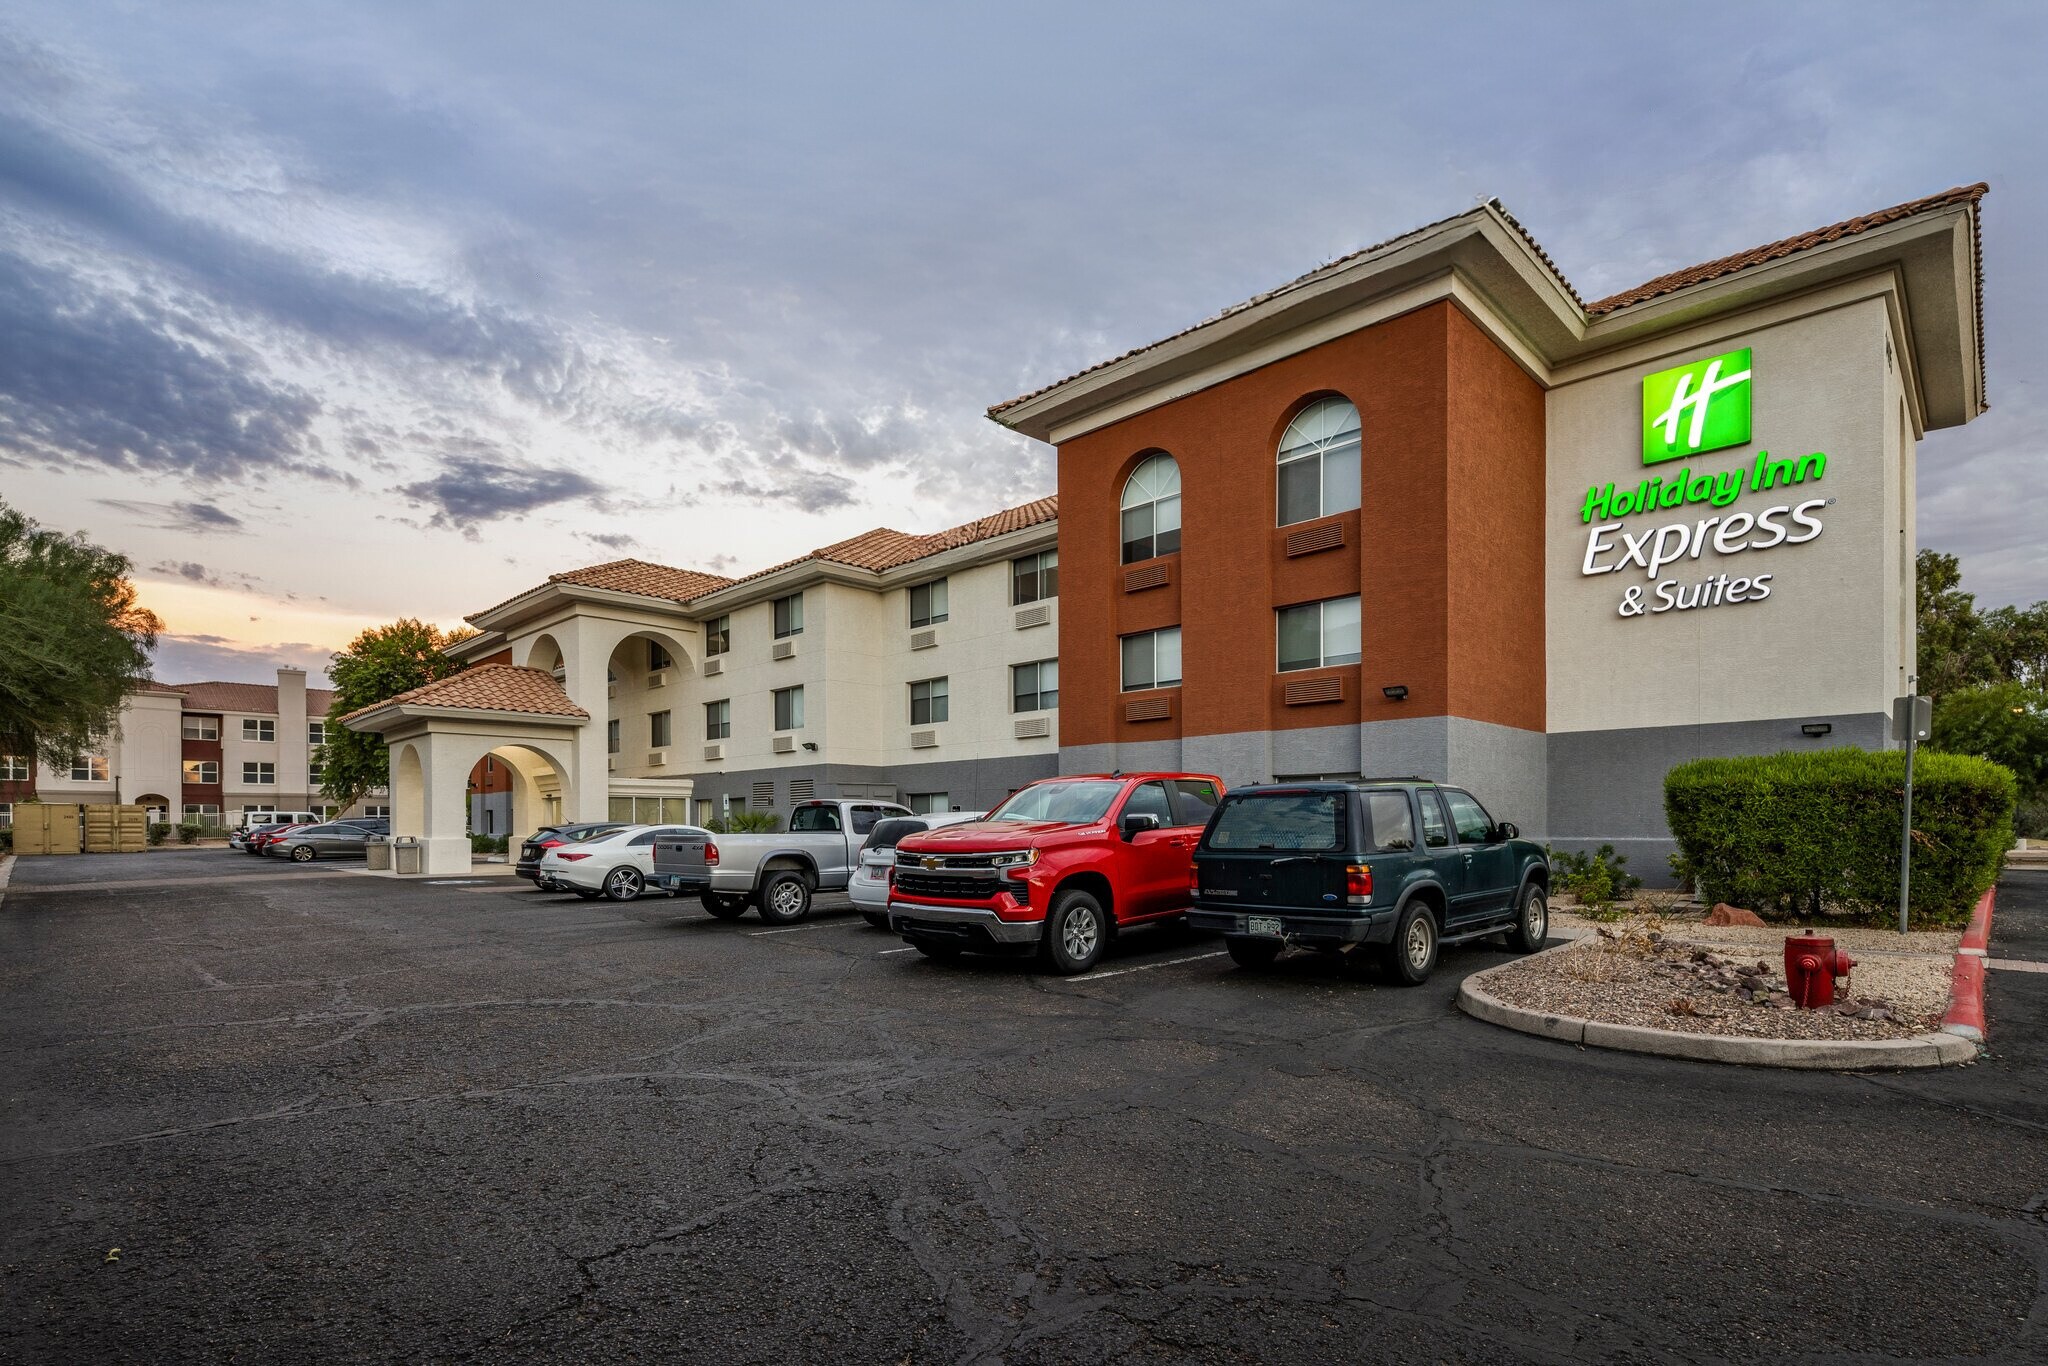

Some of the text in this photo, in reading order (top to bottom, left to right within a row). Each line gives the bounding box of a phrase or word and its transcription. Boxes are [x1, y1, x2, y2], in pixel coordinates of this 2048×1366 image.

[1653, 360, 1751, 448] H
[1581, 451, 1826, 522] Holiday Inn
[1617, 573, 1773, 618] & Suites
